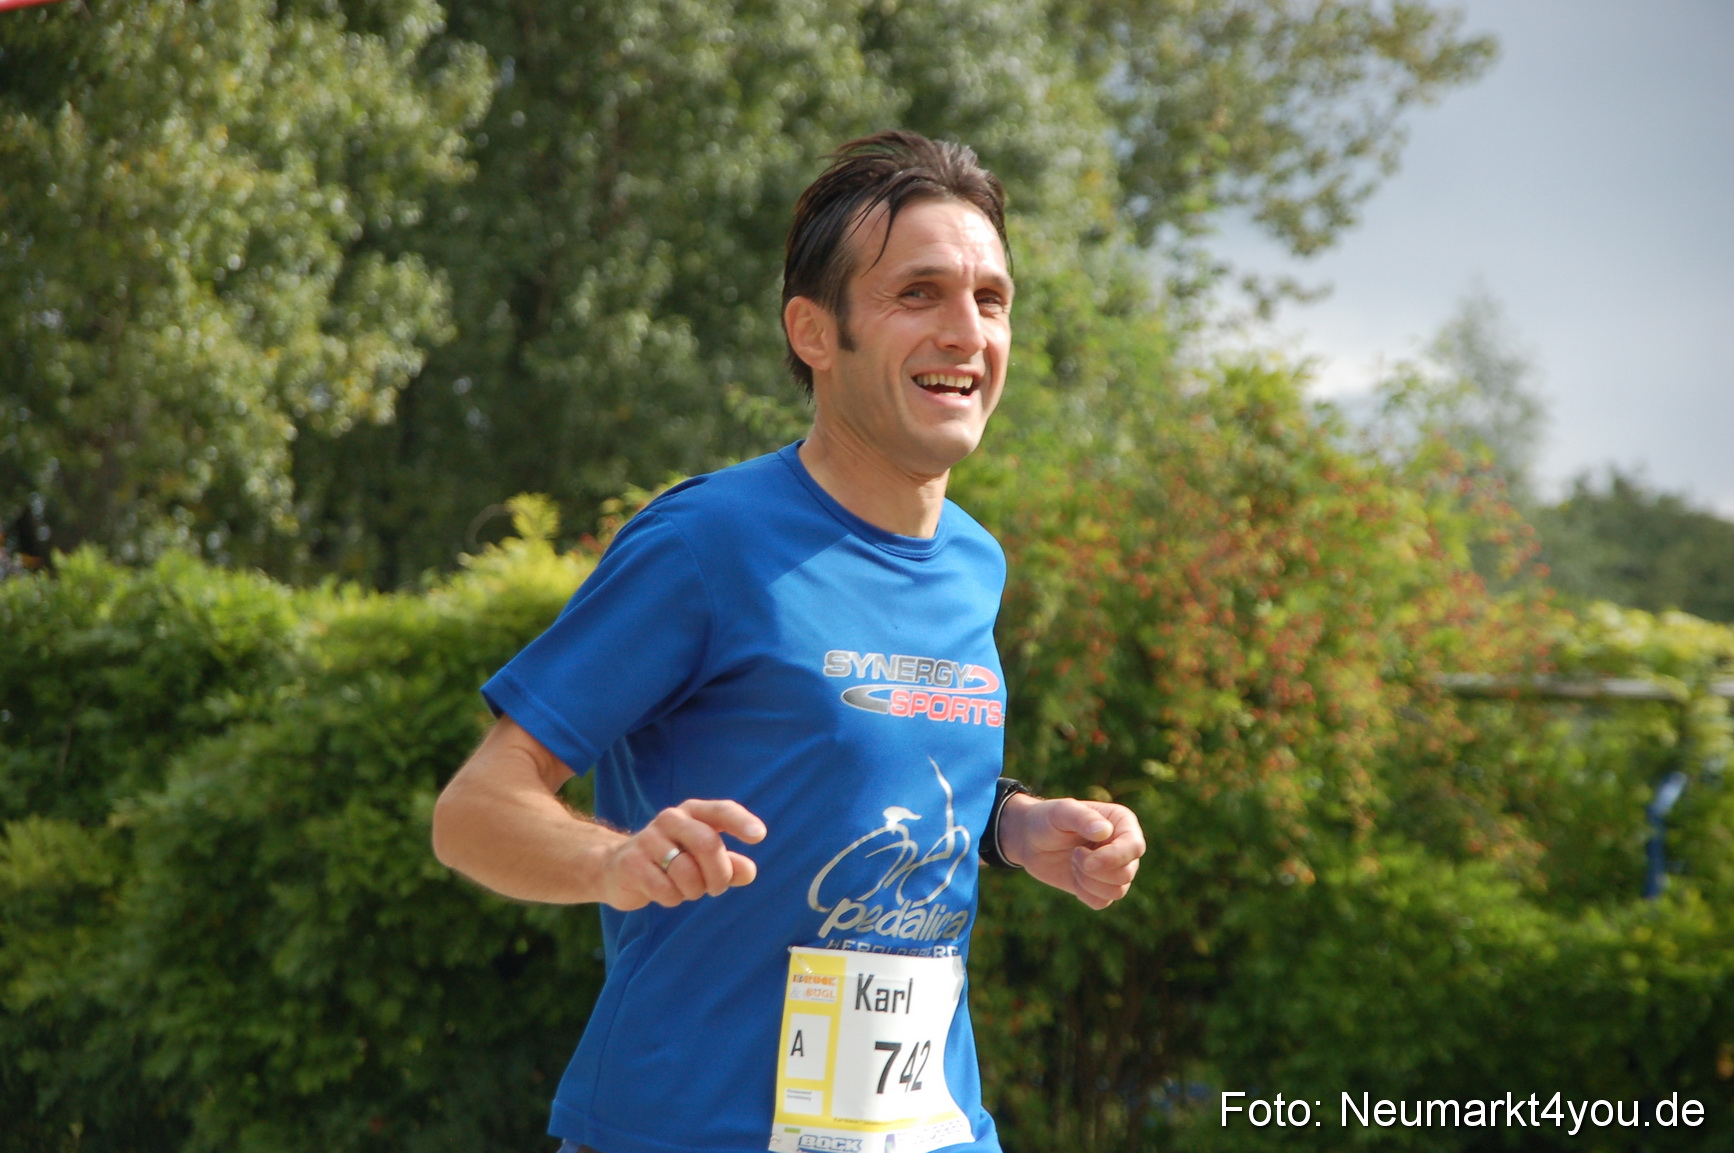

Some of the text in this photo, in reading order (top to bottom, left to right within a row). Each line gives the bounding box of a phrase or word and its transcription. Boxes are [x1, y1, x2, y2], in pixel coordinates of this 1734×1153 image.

[823, 650, 972, 688] SYNERGY
[889, 689, 1002, 727] SPORTS
[855, 973, 913, 1014] Karl
[790, 1029, 804, 1057] A
[874, 1040, 931, 1095] 742
[799, 1134, 863, 1151] BOCK
